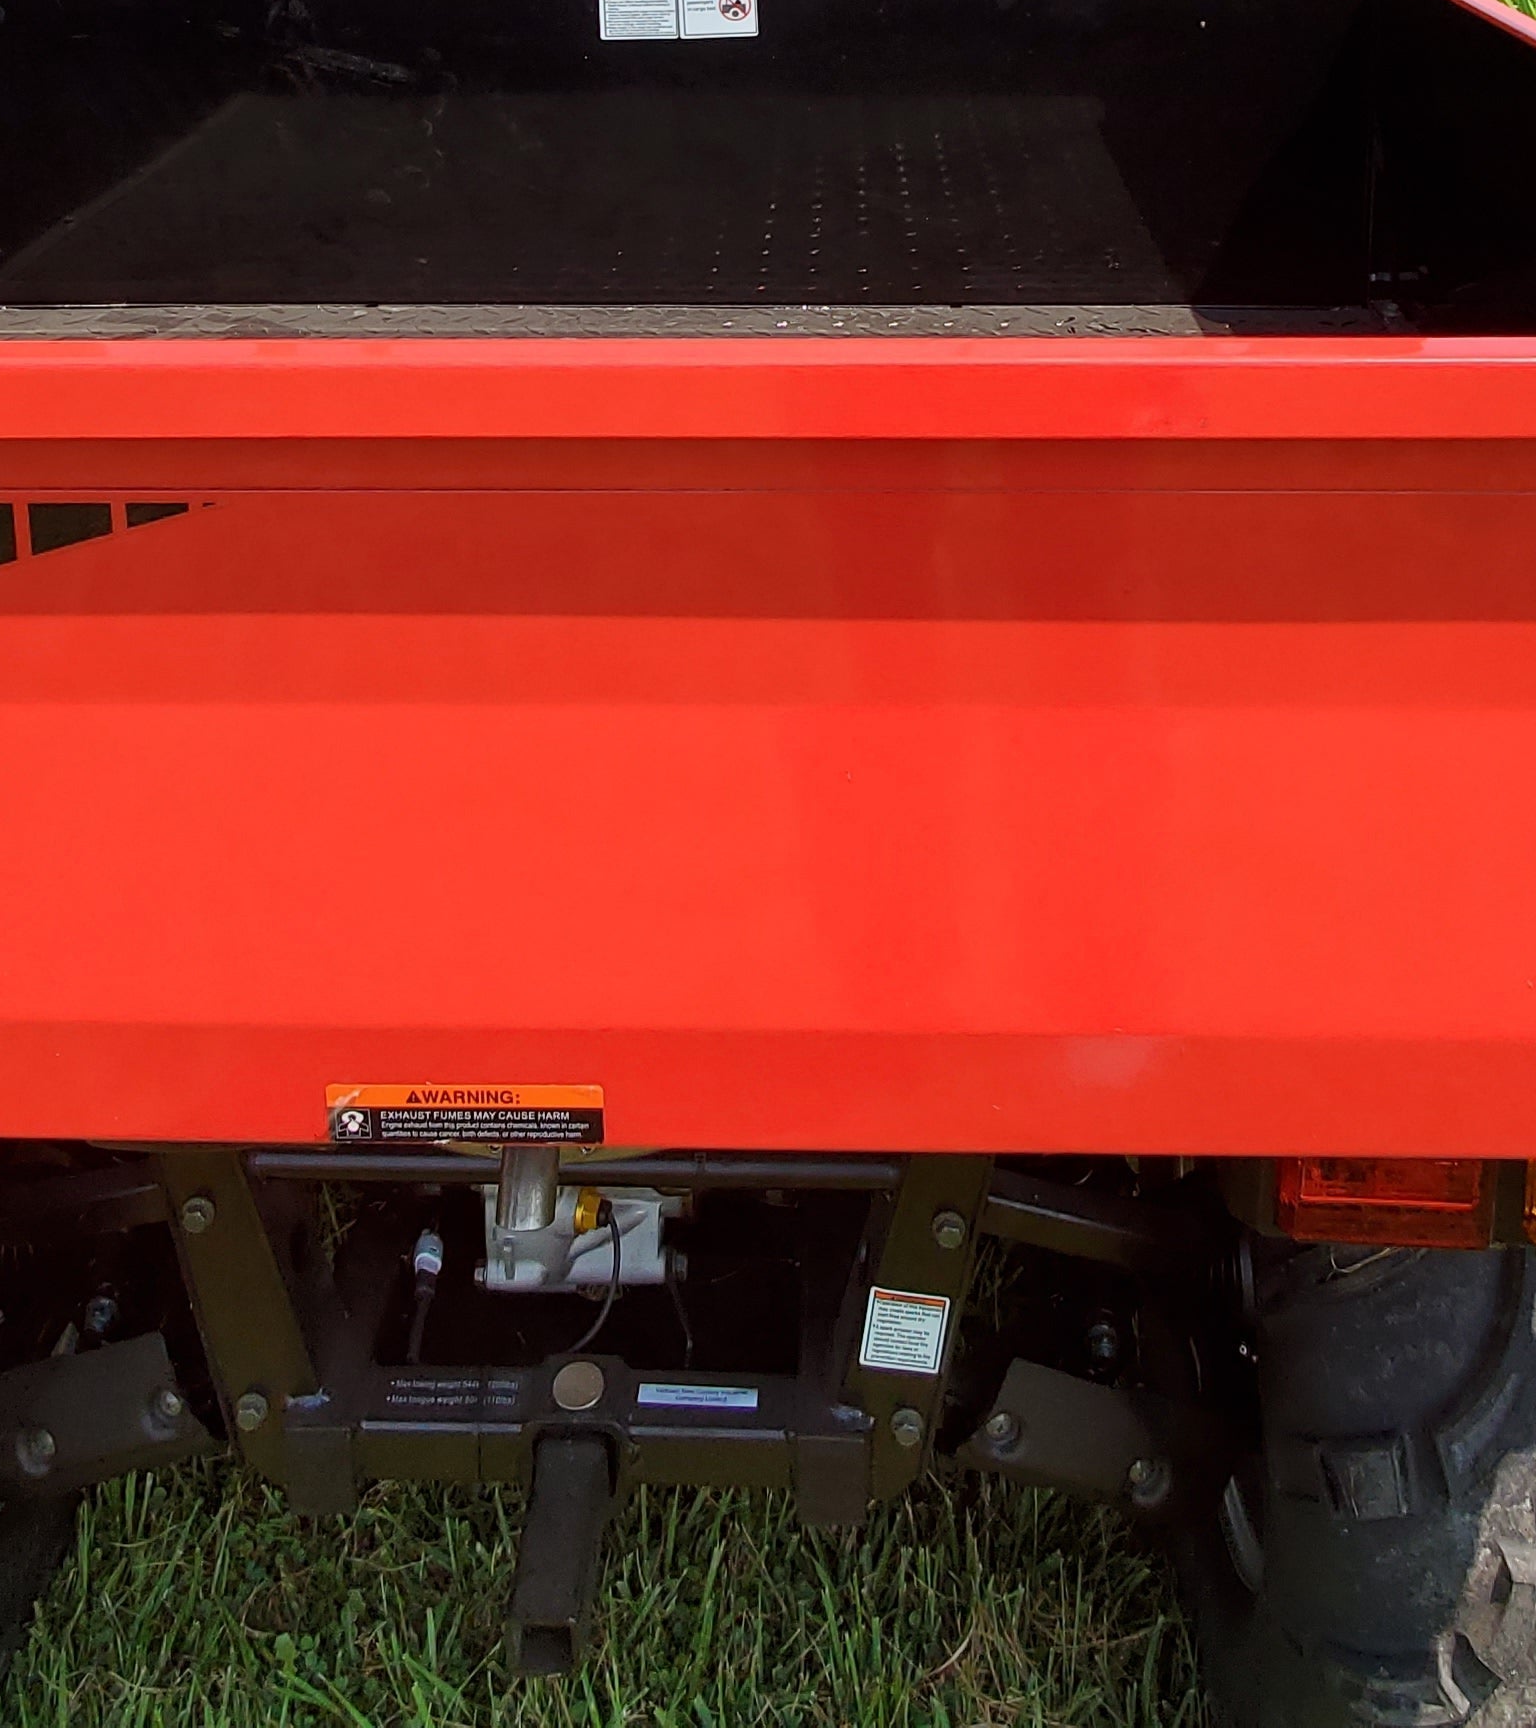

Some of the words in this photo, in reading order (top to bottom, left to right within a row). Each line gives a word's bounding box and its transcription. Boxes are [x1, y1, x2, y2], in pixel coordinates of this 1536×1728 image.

[421, 1090, 521, 1105] WARNING:
[380, 1111, 431, 1120] EXHAUST
[433, 1111, 471, 1120] FUMES
[473, 1111, 496, 1120] MAY
[498, 1111, 535, 1120] CAUSE
[537, 1111, 570, 1120] HARM
